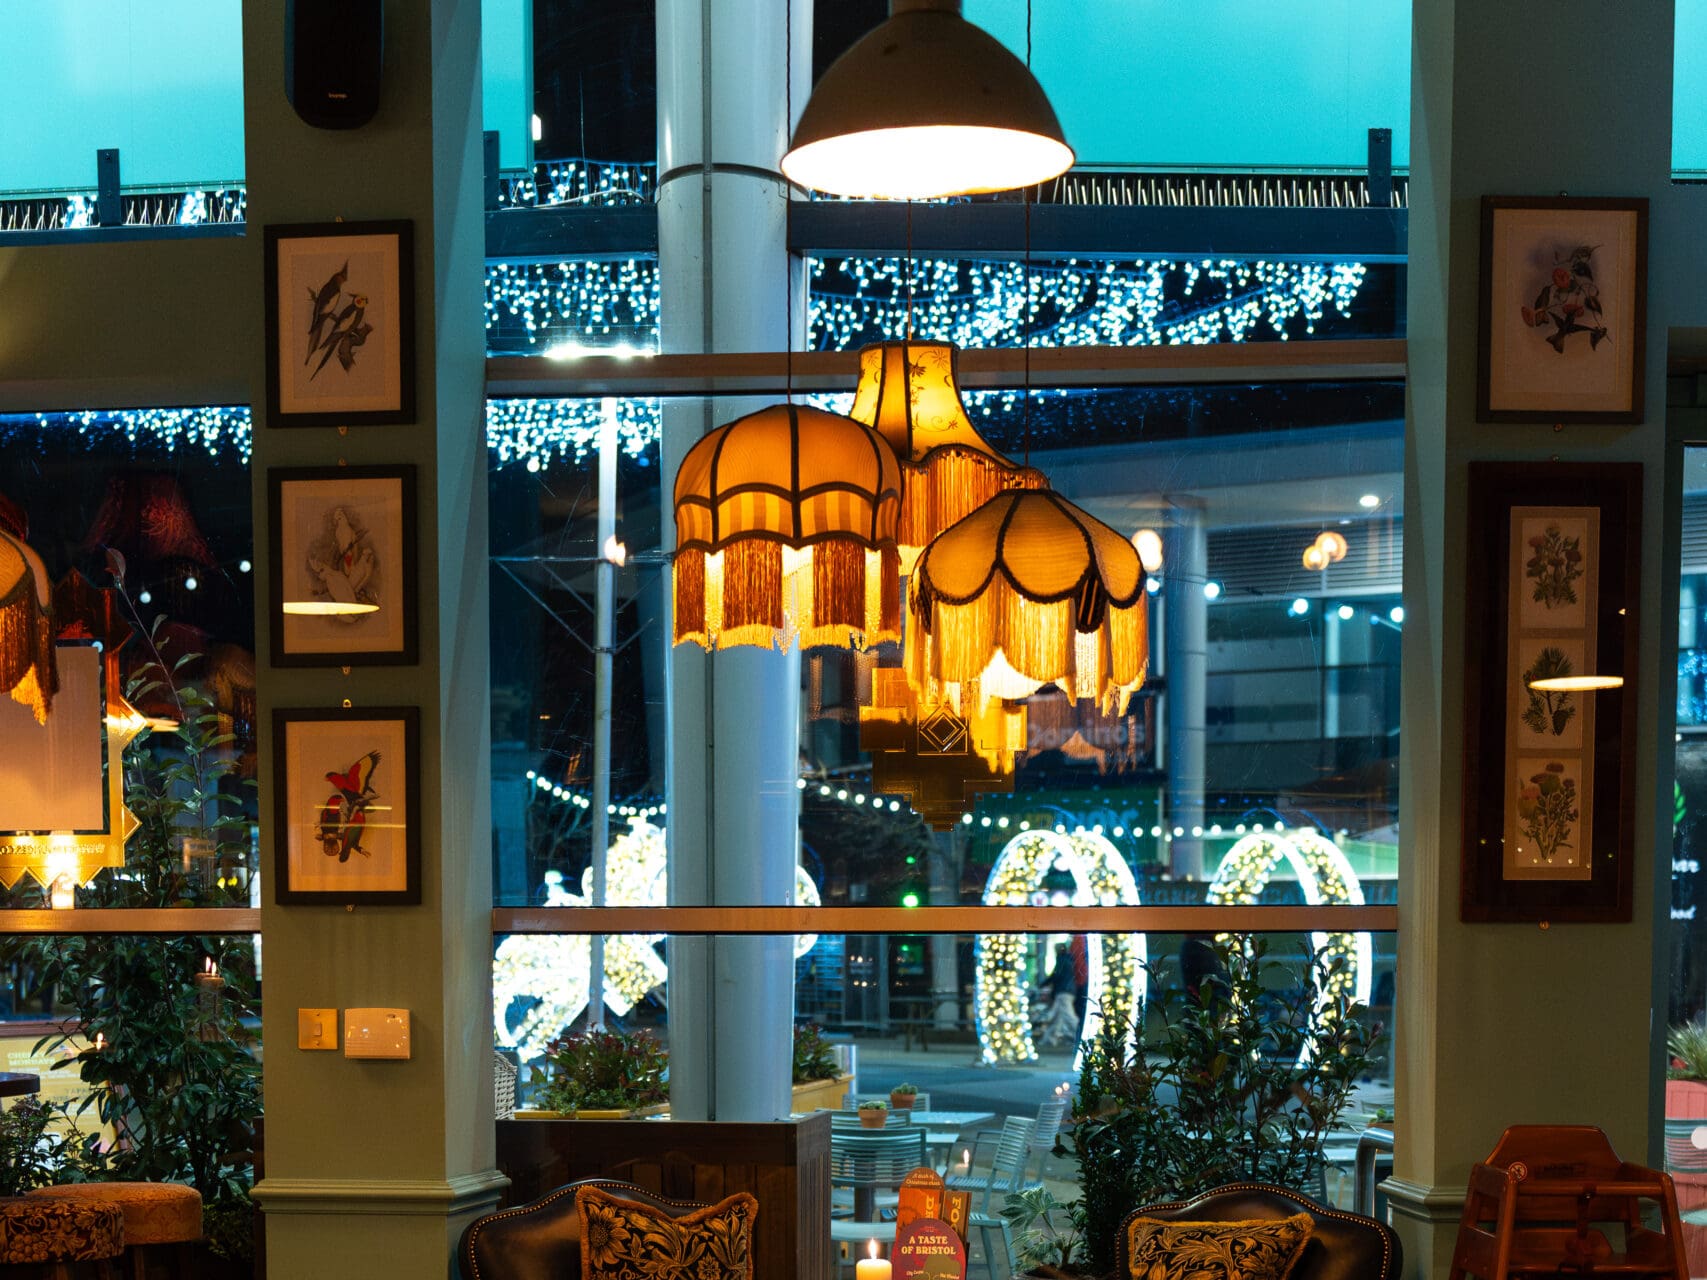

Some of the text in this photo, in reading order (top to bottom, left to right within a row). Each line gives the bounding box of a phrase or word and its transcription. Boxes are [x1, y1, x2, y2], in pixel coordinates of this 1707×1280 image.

[1026, 719, 1146, 747] Dominos
[909, 1235, 948, 1245] A TASTE
[901, 1246, 957, 1255] OF BRISTOL
